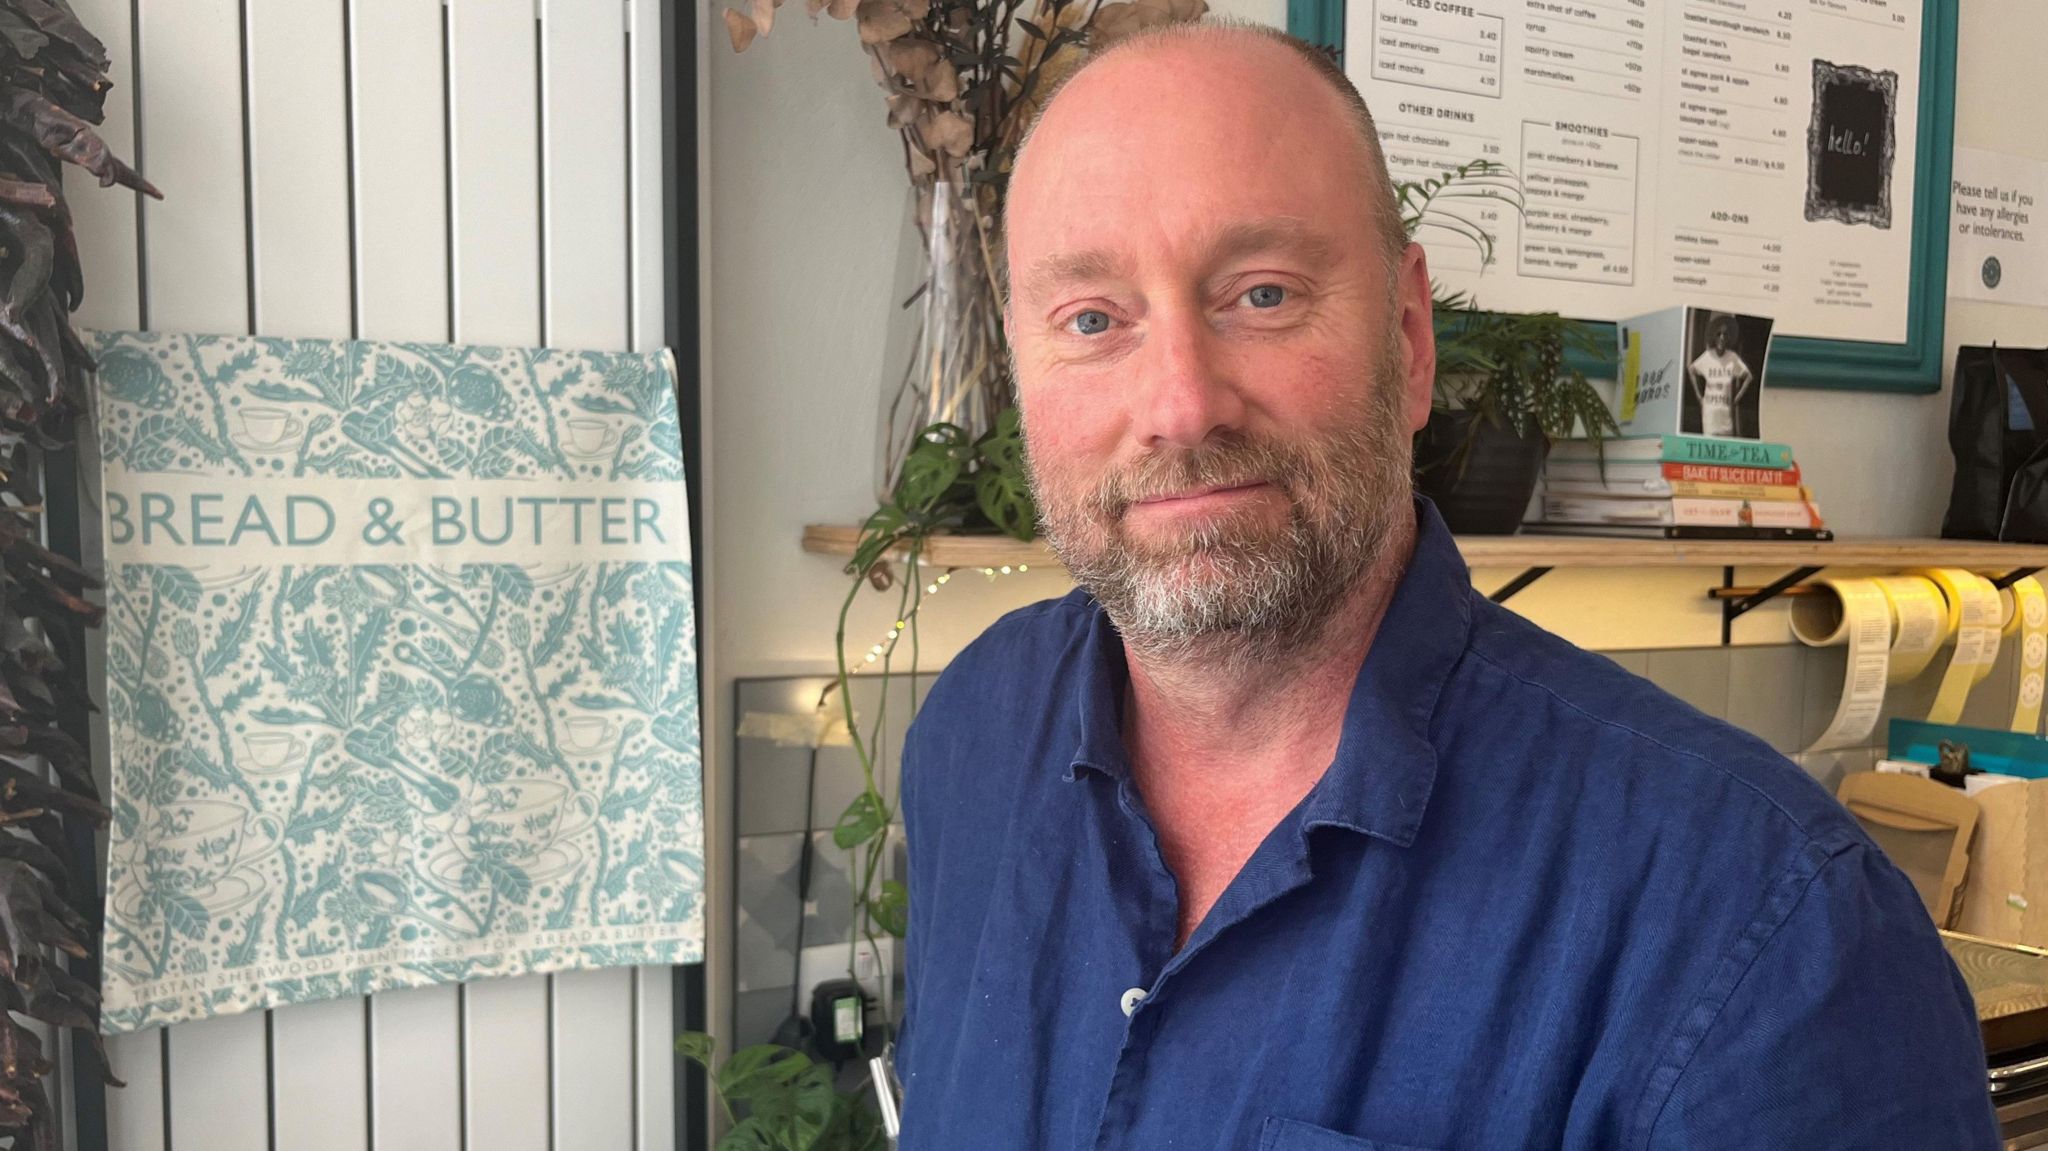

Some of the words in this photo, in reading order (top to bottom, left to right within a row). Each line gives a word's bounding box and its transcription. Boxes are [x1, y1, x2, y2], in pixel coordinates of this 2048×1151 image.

[1434, 0, 1475, 18] COFFEE
[1526, 0, 1545, 10] extra
[1547, 3, 1563, 13] shot
[1565, 7, 1573, 15] of
[1574, 9, 1596, 19] coffee
[1380, 12, 1398, 24] iced
[1400, 16, 1418, 27] latte
[1379, 36, 1397, 47] iced
[1399, 39, 1440, 54] americano
[1552, 50, 1574, 59] cream
[1378, 60, 1397, 71] iced
[1398, 63, 1425, 75] mocha
[1523, 67, 1575, 82] marshmallows
[1399, 102, 1433, 117] OTHER
[1436, 107, 1475, 122] DRINKS
[1396, 130, 1410, 141] hot
[1412, 133, 1450, 147] chocolate
[1555, 121, 1608, 138] SMOOTHIES
[1827, 124, 1870, 157] hello!
[1389, 155, 1415, 167] Origin
[1416, 157, 1430, 168] hot
[1952, 180, 1982, 199] Please
[1984, 186, 1998, 200] tell
[2000, 191, 2009, 203] us
[2011, 189, 2018, 203] if
[2018, 194, 2034, 208] you
[1710, 210, 1749, 224] ADD-ONS
[1956, 200, 1978, 217] have
[1980, 206, 1995, 222] any
[1996, 206, 2029, 226] allergies
[1958, 223, 1970, 235] or
[1686, 440, 1727, 460] TIME
[1740, 445, 1770, 465] TEA
[1682, 464, 1707, 481] BAKE
[1709, 466, 1718, 482] IT
[1720, 467, 1745, 483] SLICE
[1746, 469, 1755, 484] IT
[1757, 469, 1773, 485] EAT
[1774, 470, 1783, 484] IT
[107, 492, 336, 547] BREAD
[362, 497, 406, 547] &
[431, 495, 668, 546] BUTTER
[132, 976, 206, 1002] TRISTAN
[217, 956, 334, 985] SHERWOOD
[482, 937, 517, 952] FOR
[535, 929, 593, 946] BREAD
[598, 930, 608, 941] &
[614, 924, 680, 940] BUTTER
